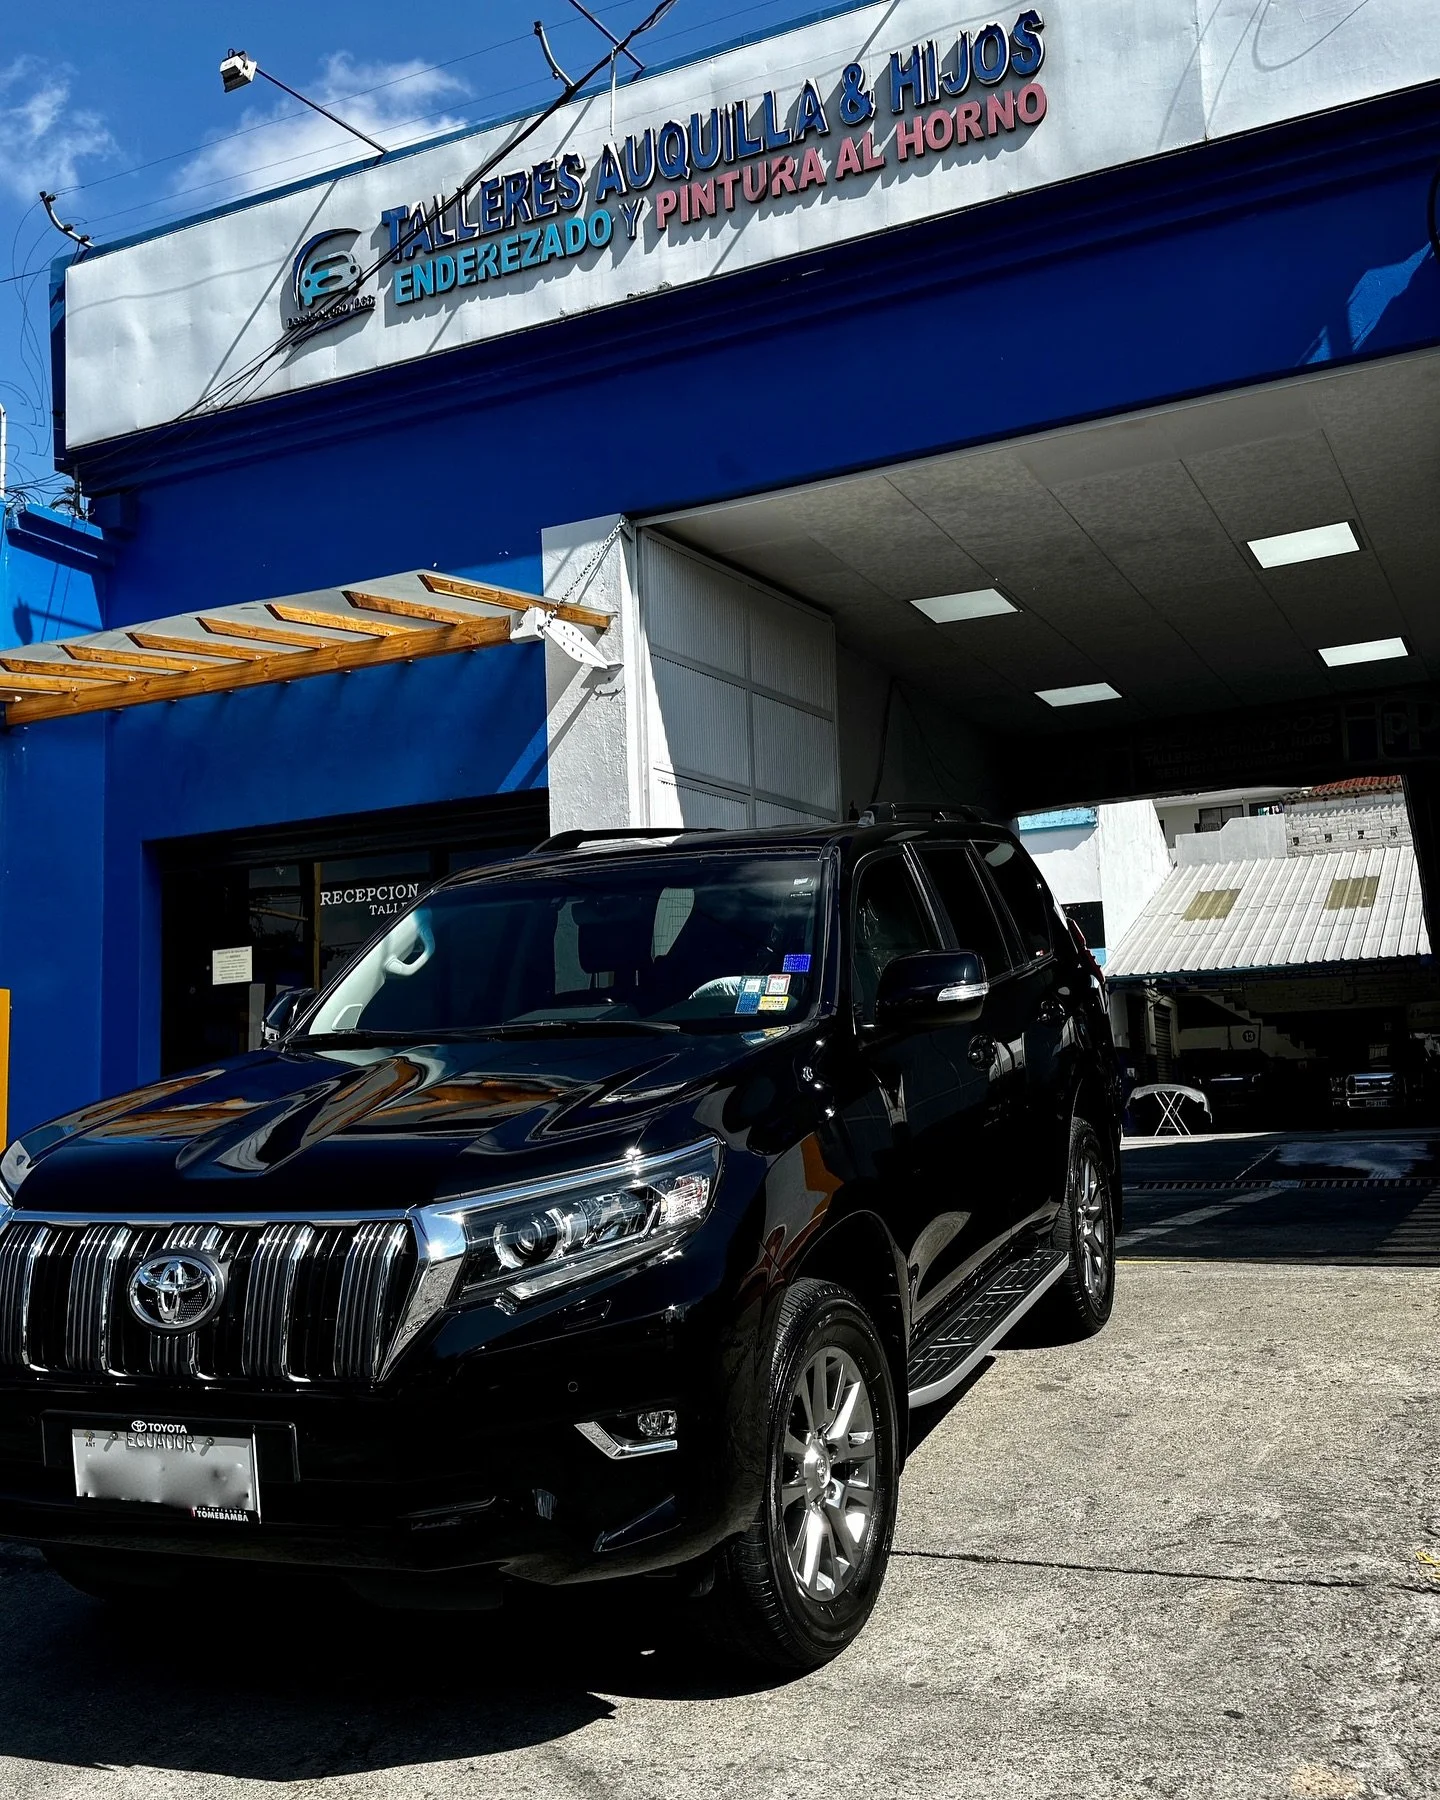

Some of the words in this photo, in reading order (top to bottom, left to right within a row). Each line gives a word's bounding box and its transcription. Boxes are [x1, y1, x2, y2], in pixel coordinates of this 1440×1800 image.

[381, 153, 586, 262] TALLERES
[599, 78, 830, 201] AUQUILLA
[840, 62, 877, 125] &
[890, 10, 1045, 114] HIJOS
[394, 208, 613, 305] ENDEREZADO
[619, 198, 651, 240] Y
[655, 145, 826, 230] PINTURA
[834, 136, 885, 179] AL
[896, 82, 1048, 158] HORNO
[320, 883, 419, 906] RECEPCION
[1245, 1032, 1254, 1041] 13
[147, 1423, 188, 1434] TOYOTA
[126, 1432, 196, 1451] ECUADOR
[196, 1510, 249, 1522] TOMEBAMBA
